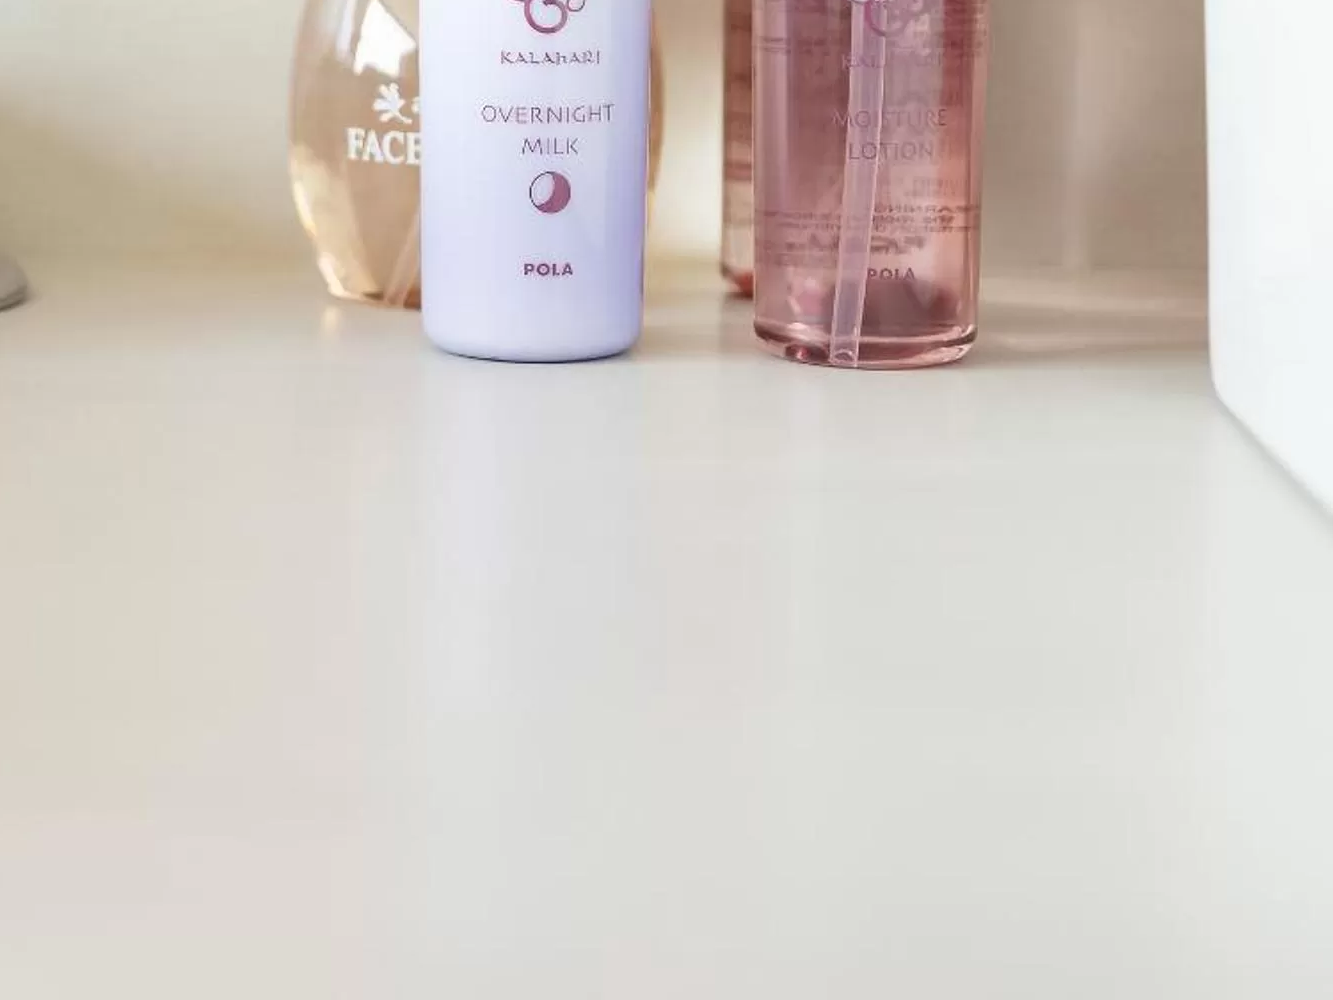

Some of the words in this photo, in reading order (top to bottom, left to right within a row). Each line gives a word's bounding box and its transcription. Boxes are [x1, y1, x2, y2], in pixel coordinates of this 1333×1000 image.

[481, 103, 615, 124] OVERNIGHT
[832, 108, 947, 128] MOISTURE
[521, 137, 579, 155] MILK
[848, 142, 932, 160] LOTION
[523, 262, 573, 276] POLA
[867, 267, 915, 281] POLA
